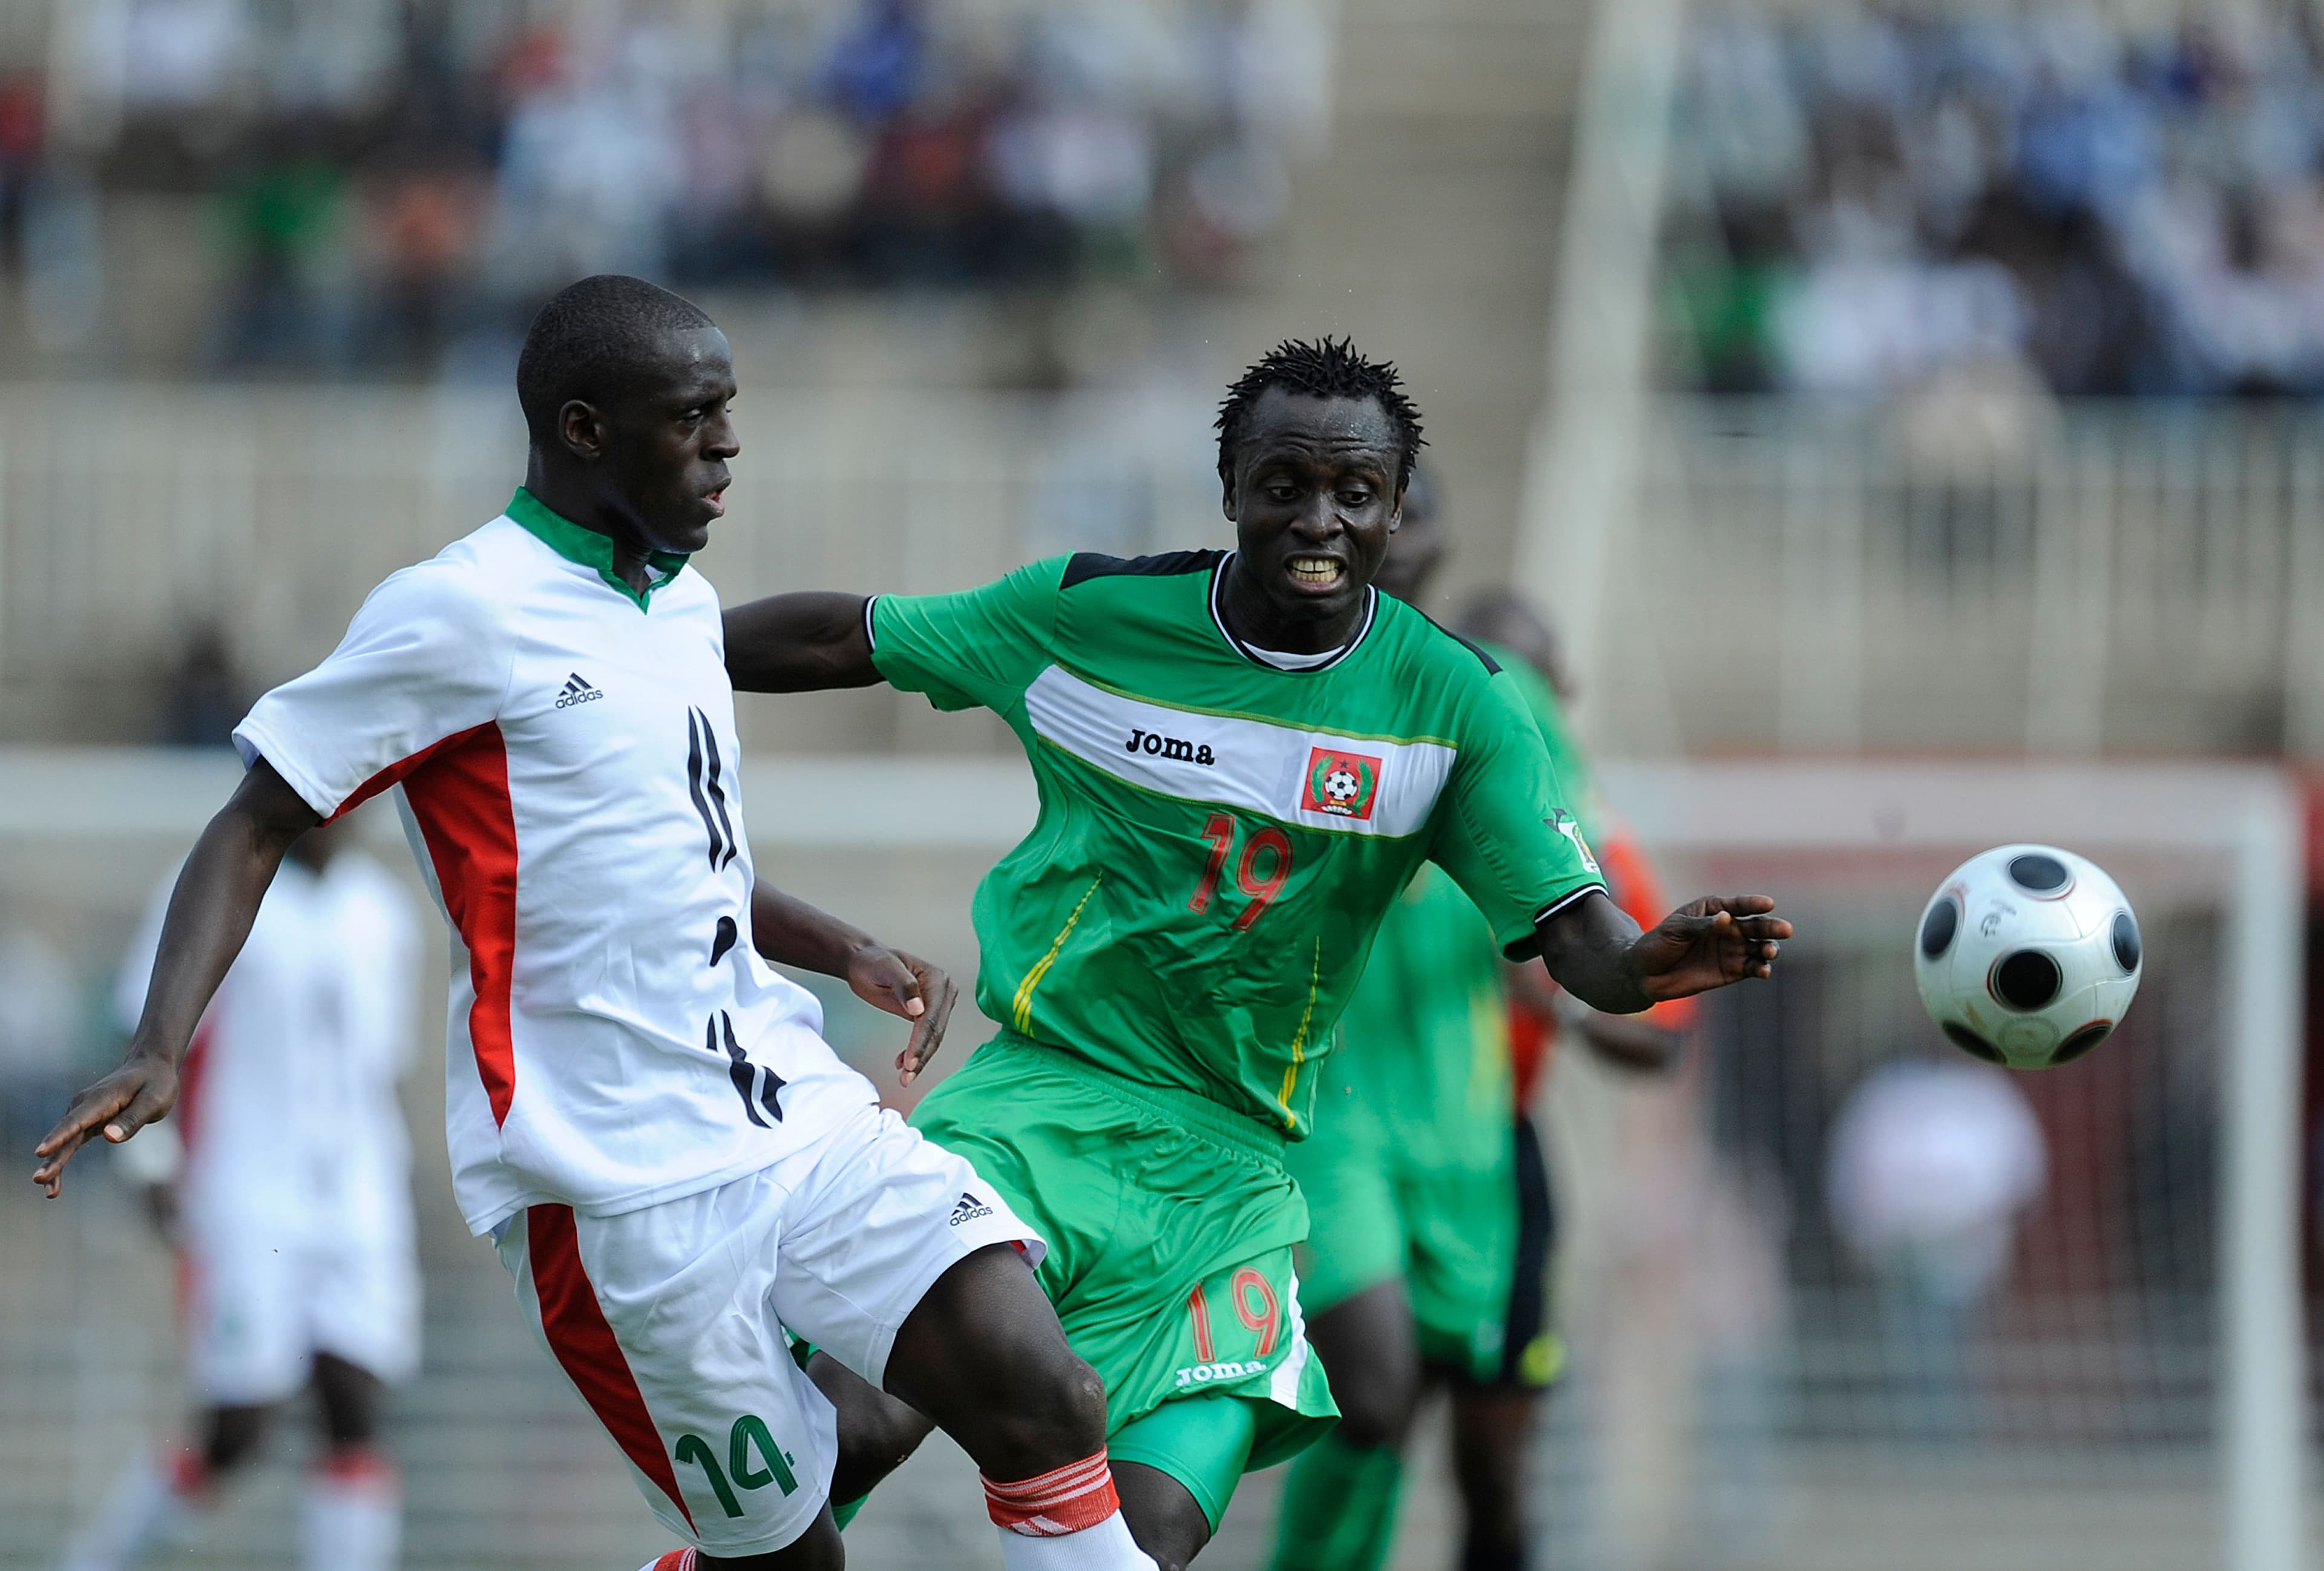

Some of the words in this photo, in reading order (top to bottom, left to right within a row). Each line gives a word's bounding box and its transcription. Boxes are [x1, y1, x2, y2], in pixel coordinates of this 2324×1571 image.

[556, 690, 603, 709] adidas
[1187, 813, 1294, 933] 19
[950, 1207, 993, 1226] adidas
[1186, 1265, 1281, 1363] 19
[675, 1414, 799, 1518] 14
